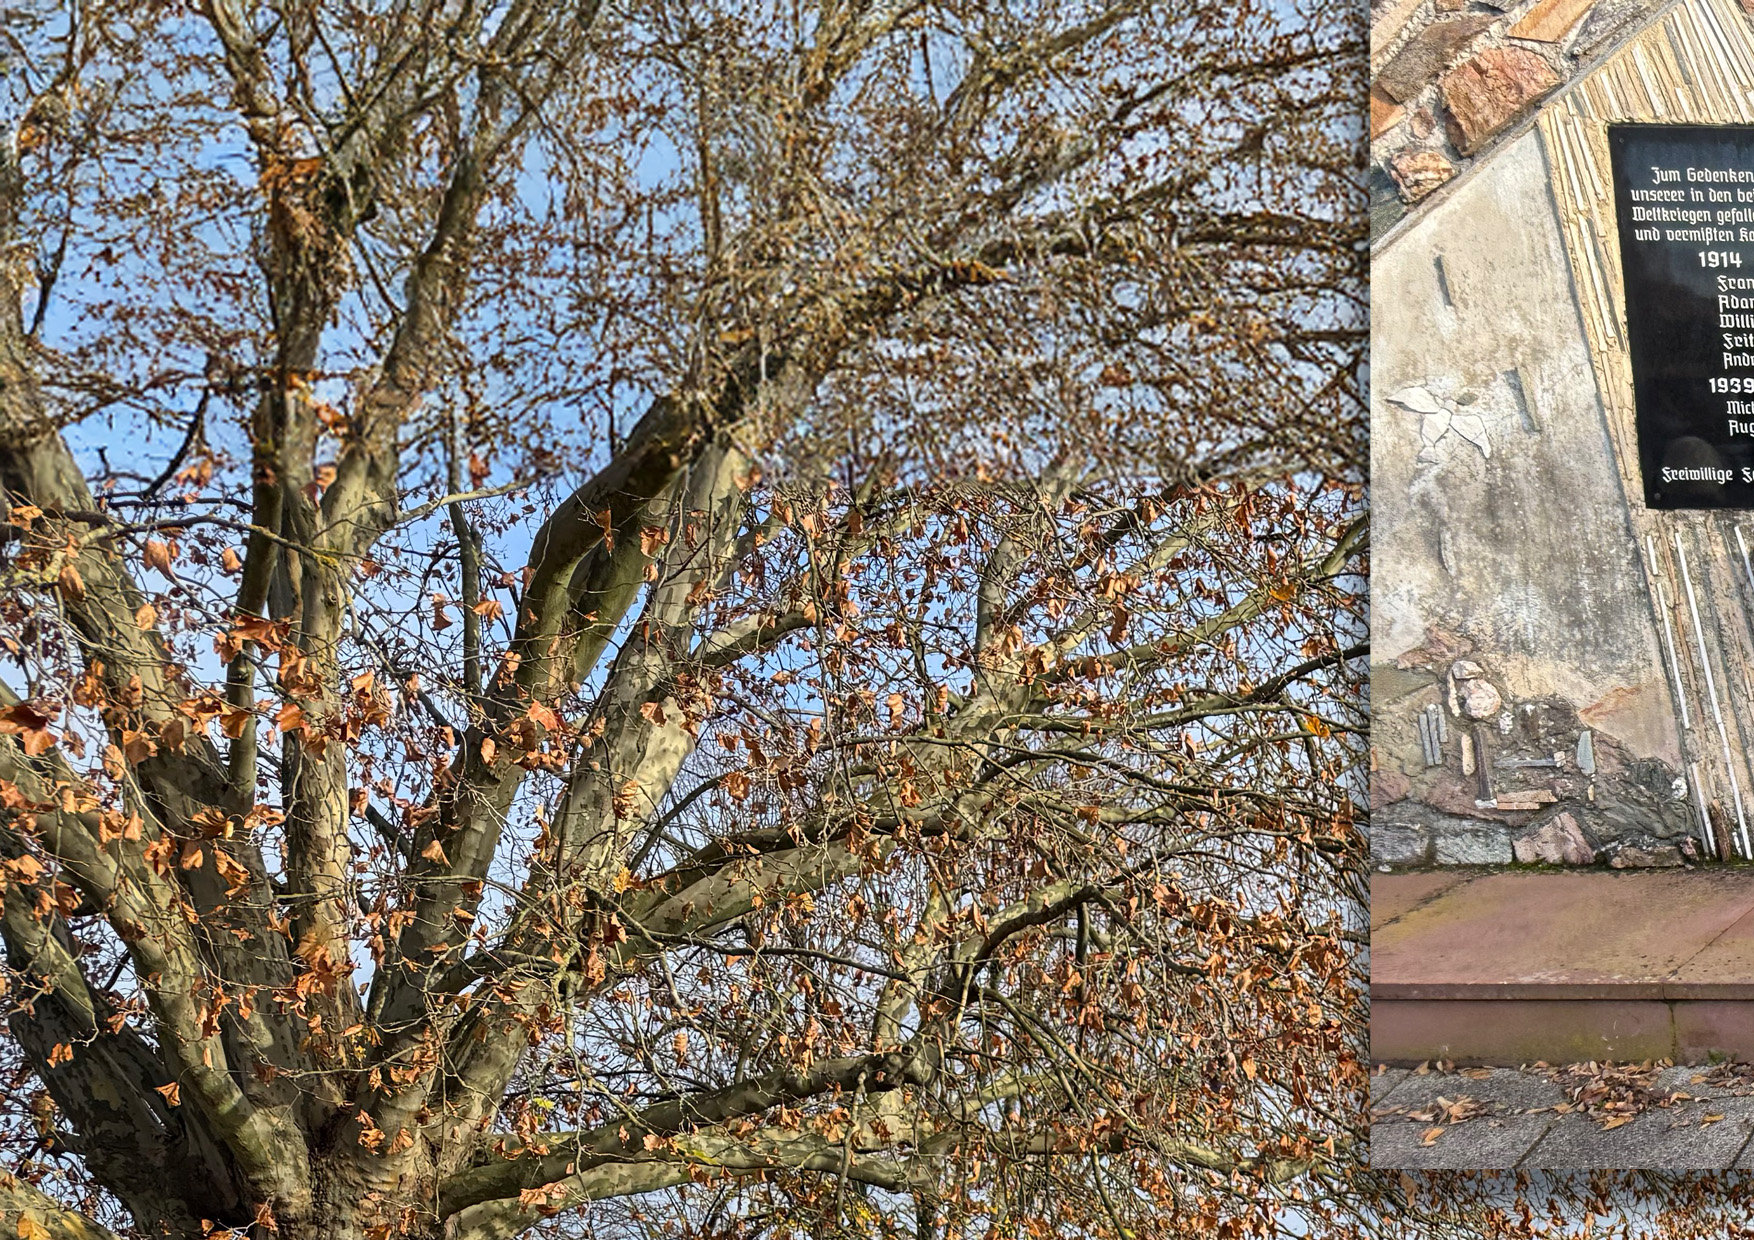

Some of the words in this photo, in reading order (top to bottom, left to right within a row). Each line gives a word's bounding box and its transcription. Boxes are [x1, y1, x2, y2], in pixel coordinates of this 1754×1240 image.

[1652, 167, 1681, 184] Zum
[1687, 167, 1754, 183] Gedenken
[1631, 190, 1686, 202] unserer
[1691, 189, 1704, 202] in
[1709, 189, 1733, 202] den
[1632, 208, 1712, 224] Weltkriegen
[1635, 227, 1660, 242] und
[1667, 227, 1734, 243] vermißten
[1699, 252, 1742, 267] 1914
[1719, 315, 1754, 328] Willi
[1709, 378, 1754, 393] 1939
[1662, 467, 1733, 483] Freiwillige
